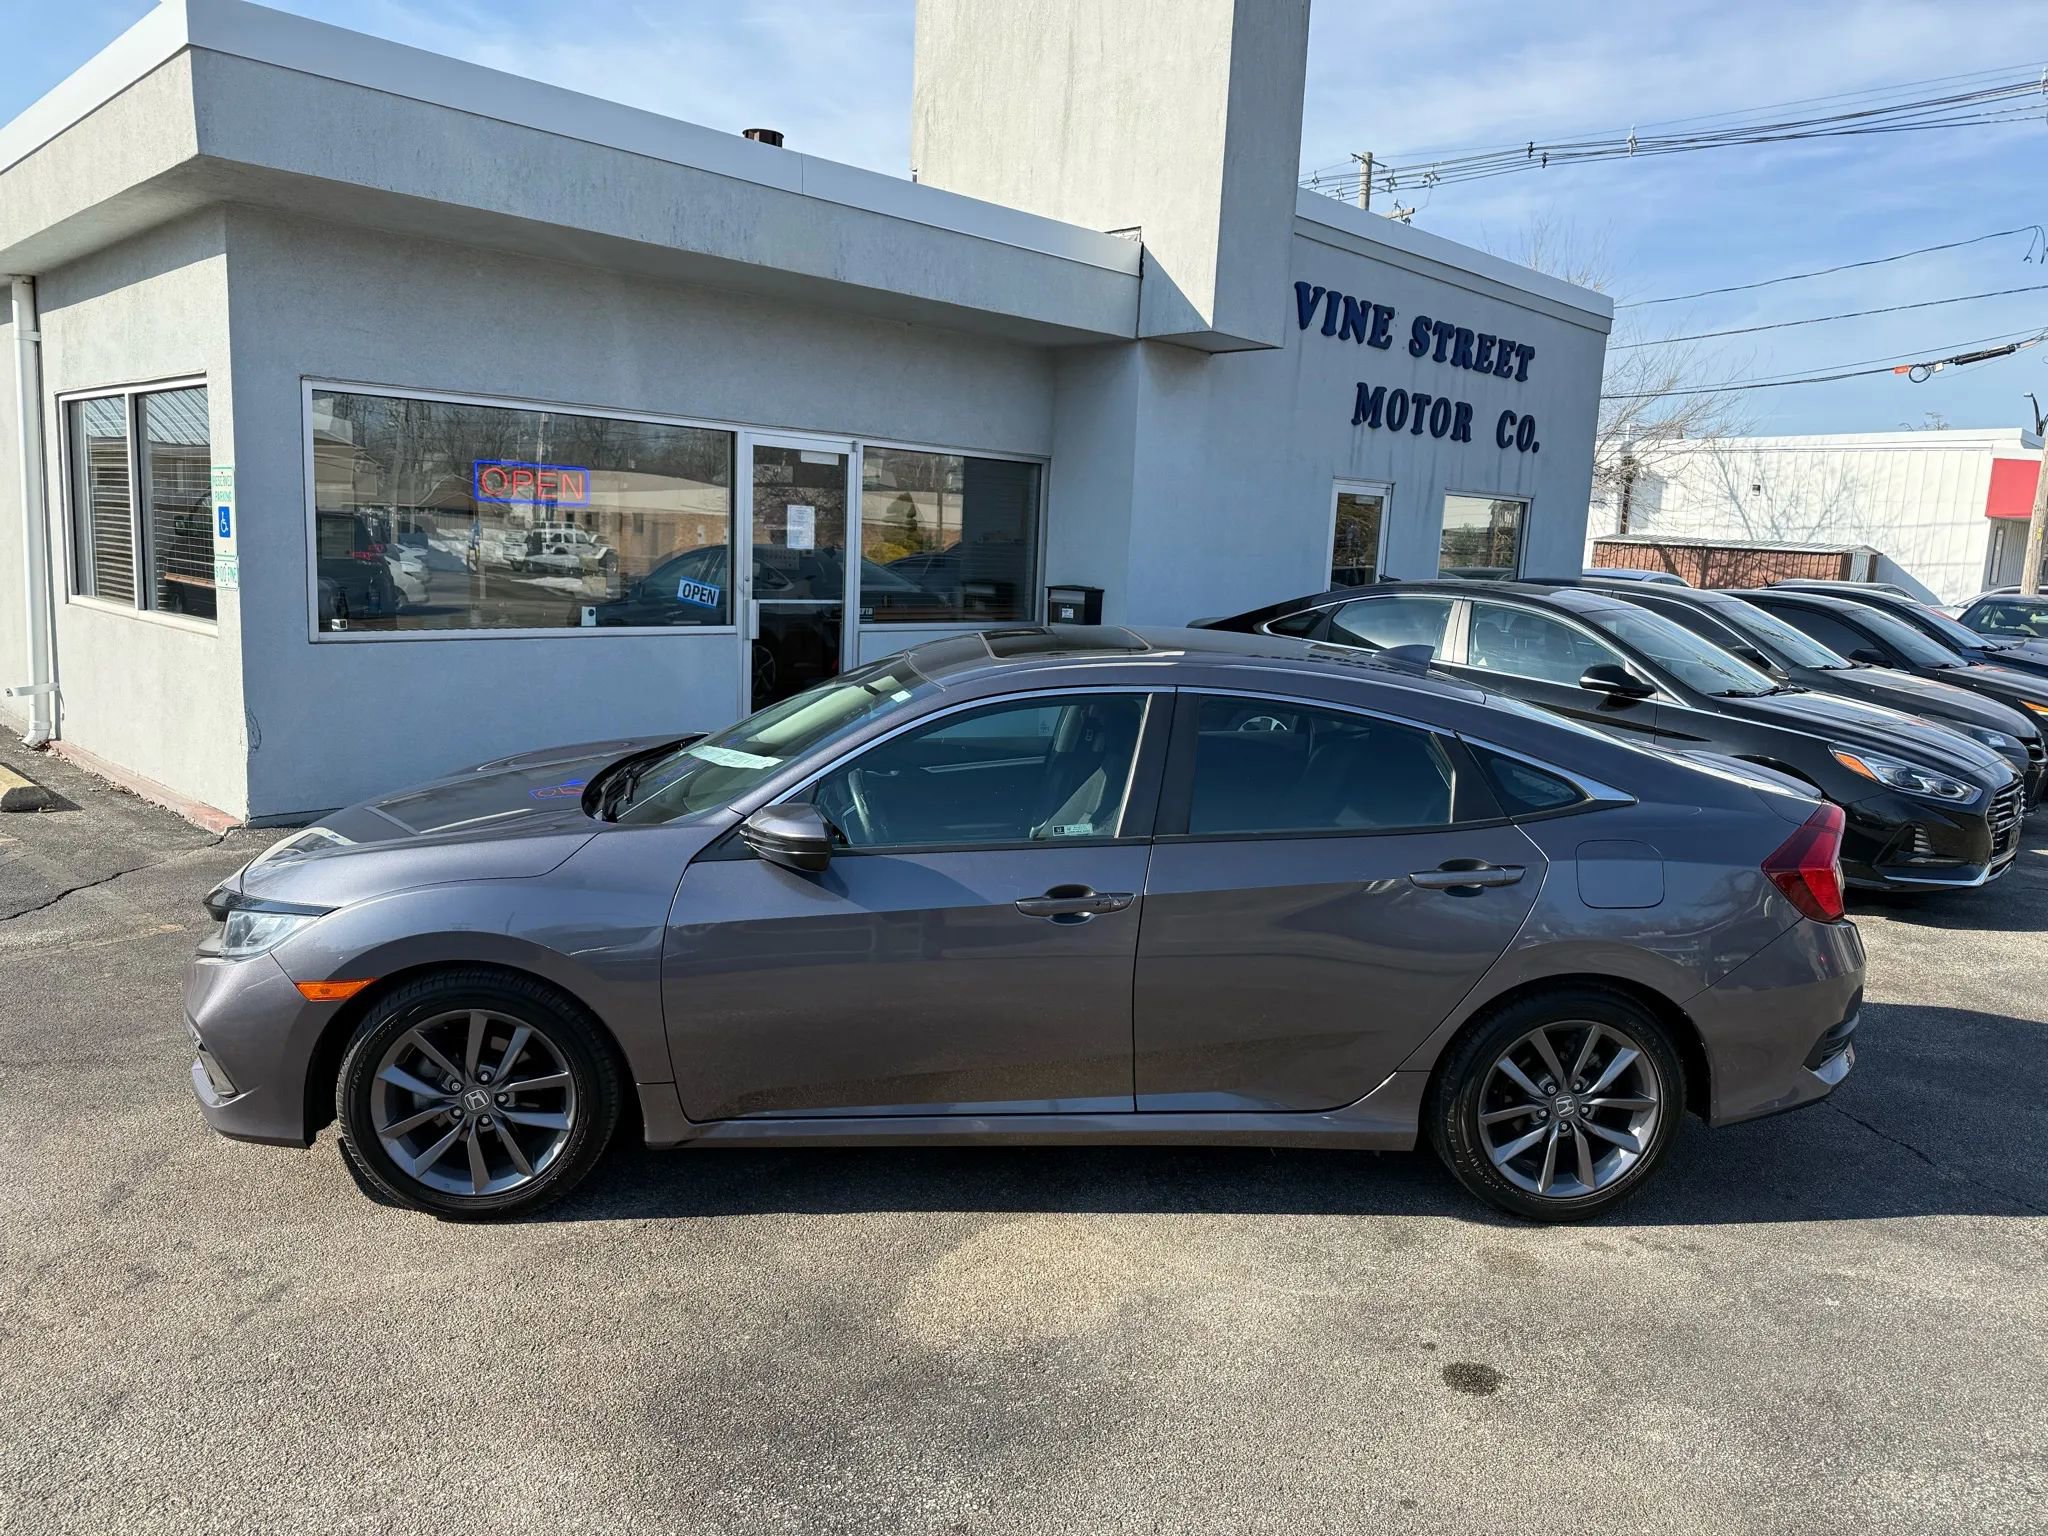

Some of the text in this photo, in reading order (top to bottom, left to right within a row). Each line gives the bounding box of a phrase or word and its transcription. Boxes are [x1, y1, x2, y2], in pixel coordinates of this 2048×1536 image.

[1294, 281, 1536, 382] VINE STREET
[1351, 382, 1540, 453] MOTOR CO.
[481, 466, 583, 500] OPEN
[682, 582, 716, 605] OPEN
